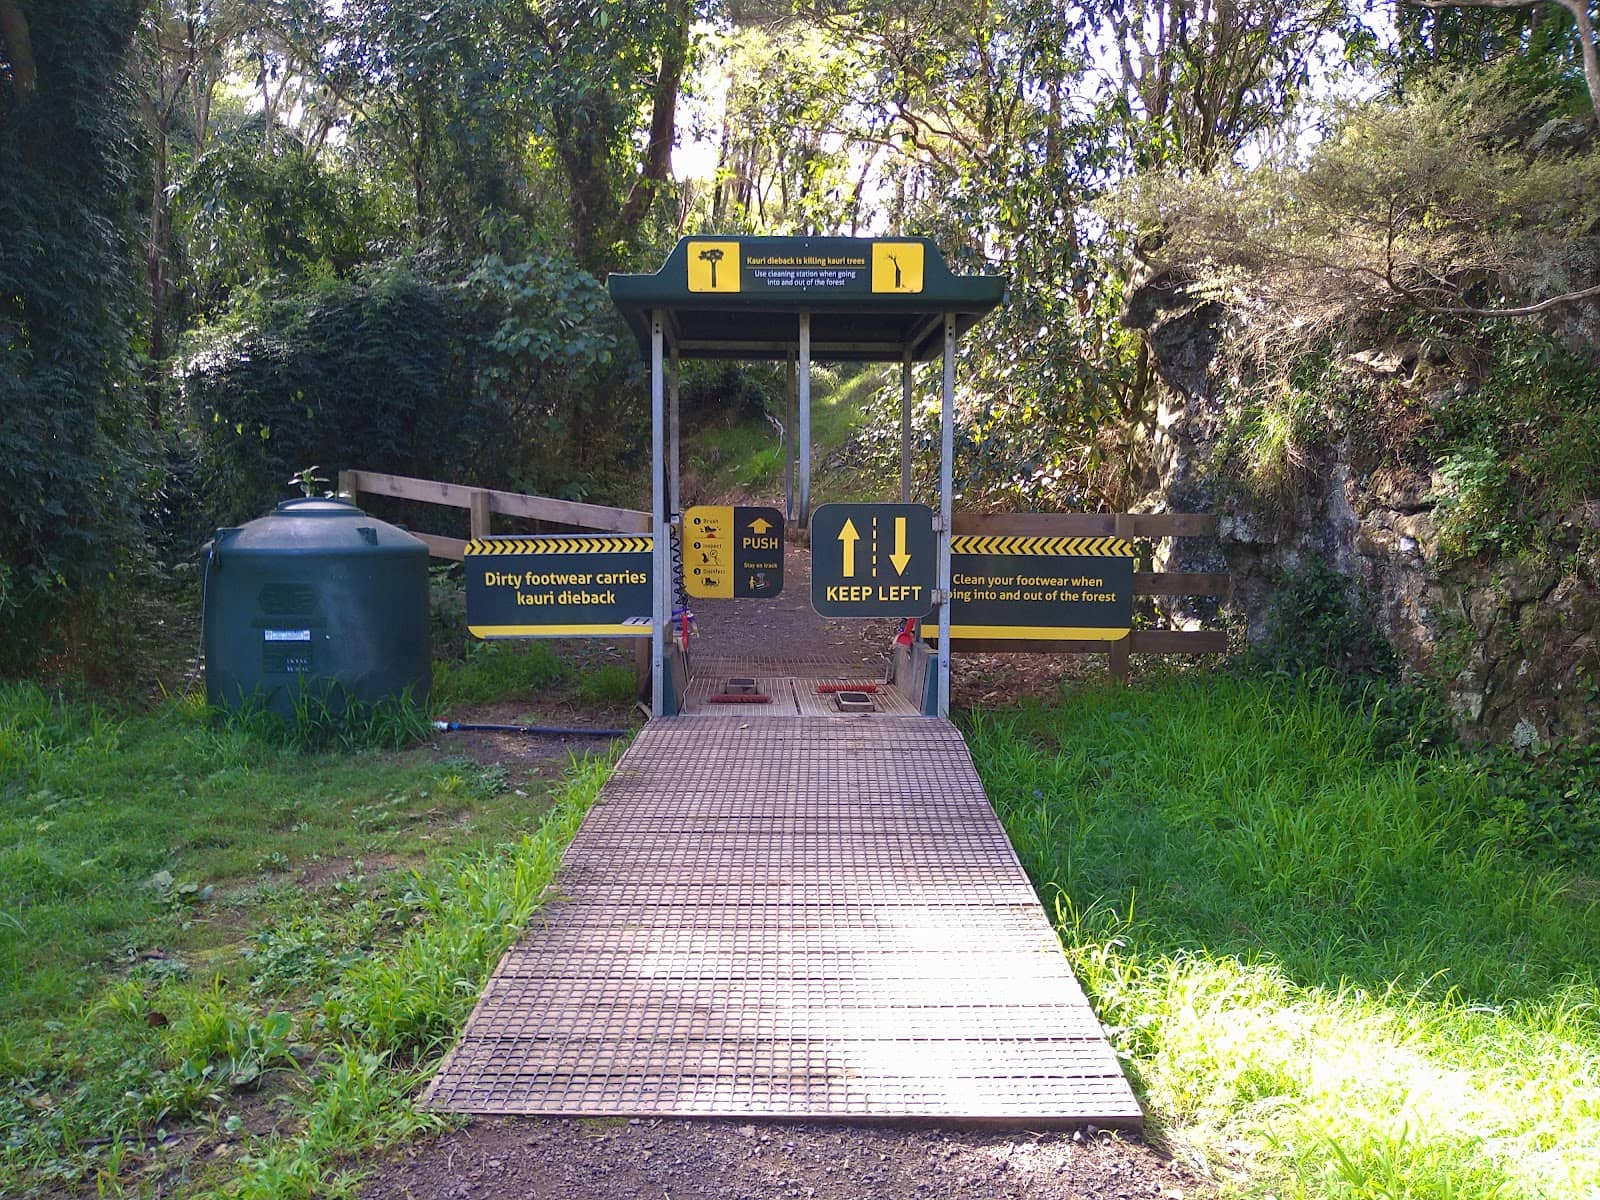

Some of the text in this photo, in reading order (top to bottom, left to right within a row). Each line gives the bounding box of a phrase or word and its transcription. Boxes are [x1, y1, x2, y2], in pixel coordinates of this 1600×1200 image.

[747, 256, 766, 264] Kauri
[767, 256, 795, 264] dieback
[796, 256, 802, 264] is
[804, 256, 826, 266] killing
[828, 256, 846, 264] kauri
[754, 270, 856, 279] Use cleaning station when going
[743, 537, 778, 550] PUSH
[484, 570, 647, 589] Dirty footwear carries
[952, 574, 1103, 588] Clean your footwear when
[517, 590, 616, 605] kauri dieback
[826, 586, 922, 602] KEEP LEFT
[948, 589, 1117, 602] oing into and out of the forest
